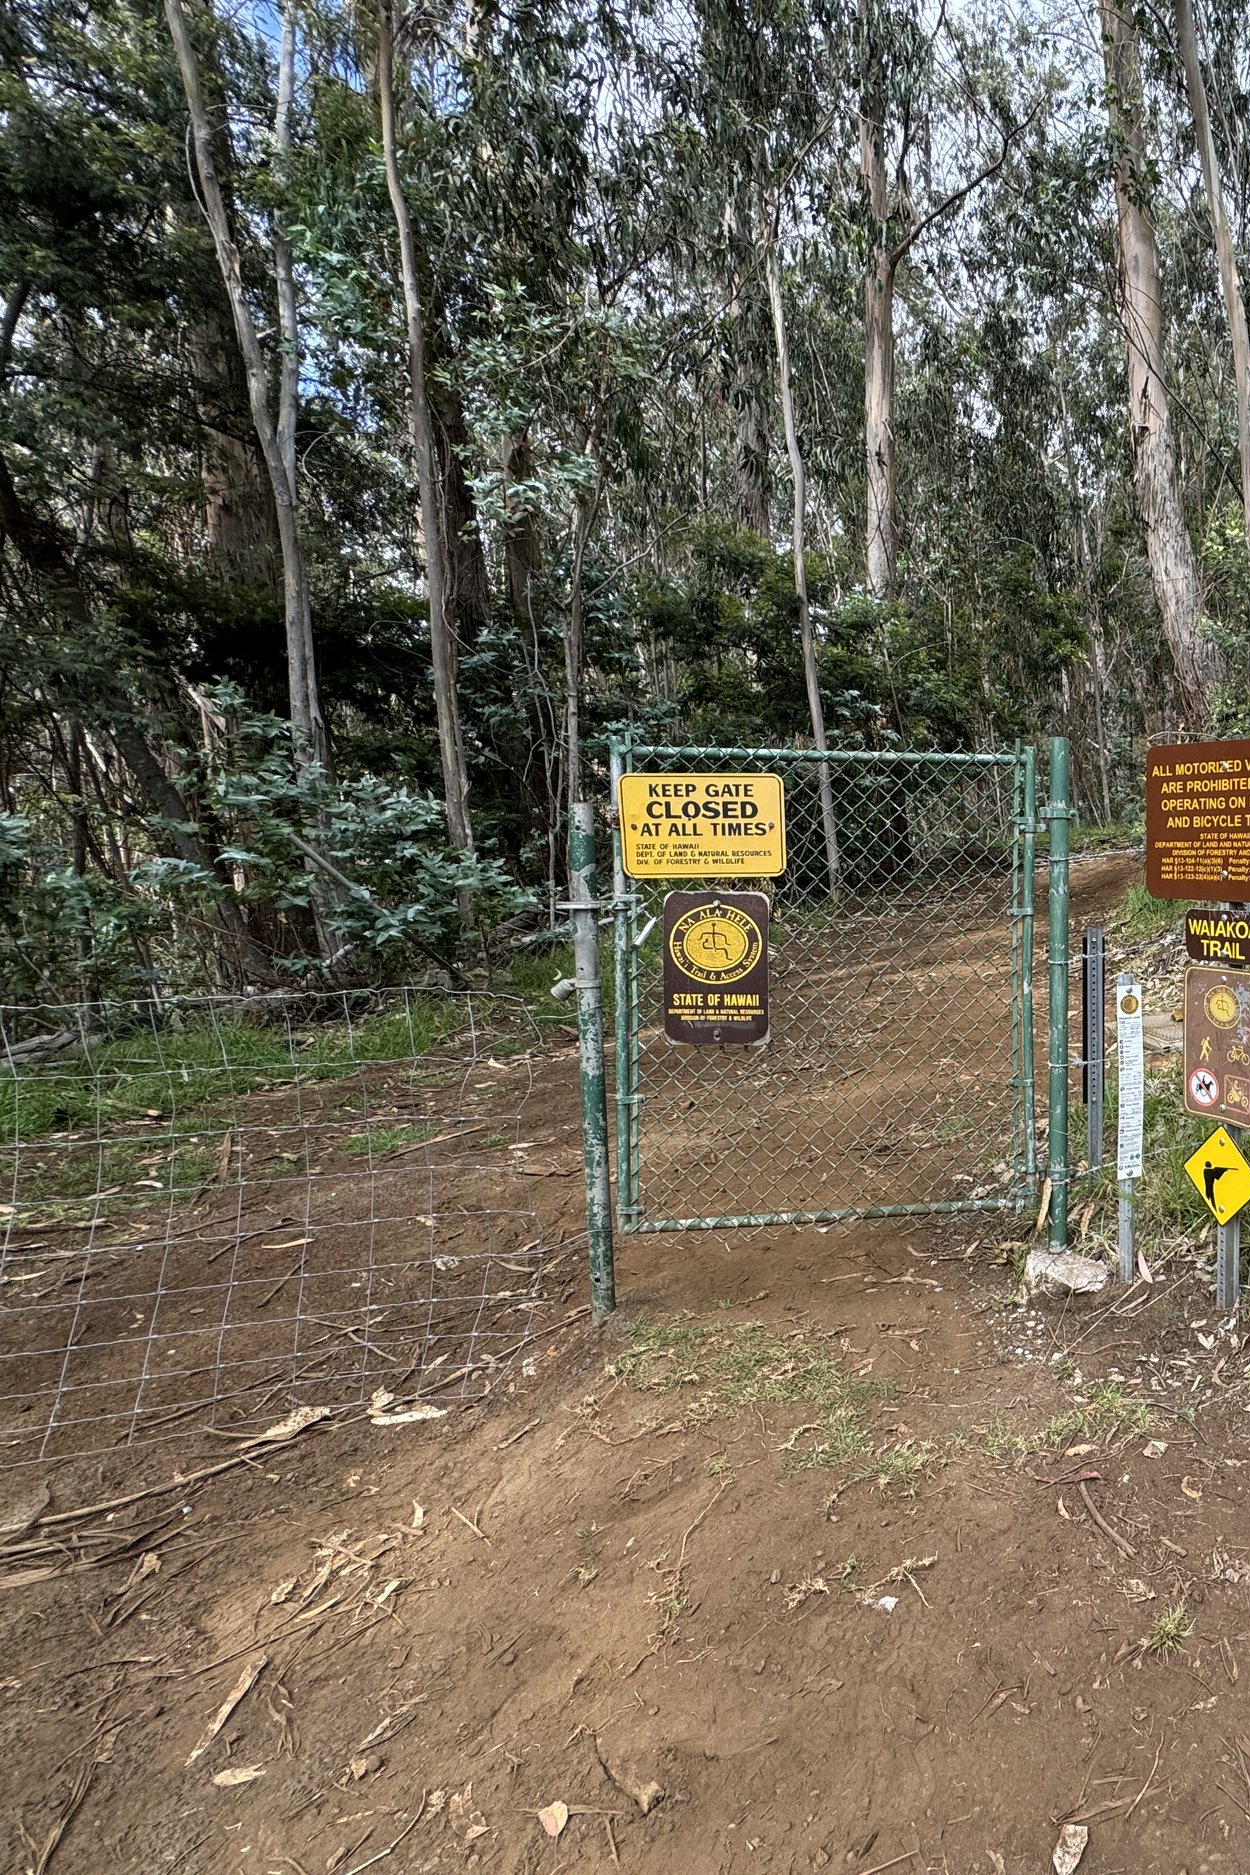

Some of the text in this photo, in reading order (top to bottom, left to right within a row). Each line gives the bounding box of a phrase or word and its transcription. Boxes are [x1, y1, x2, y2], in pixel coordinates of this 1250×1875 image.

[1152, 765, 1172, 777] ALL
[1176, 759, 1242, 775] MOTORIZED
[648, 783, 754, 798] KEEP GATE
[1161, 781, 1183, 794] ARE
[646, 800, 758, 819] CLOSED
[1161, 797, 1225, 811] OPERATING
[1229, 797, 1246, 809] ON
[1167, 816, 1190, 828] AND
[1193, 814, 1242, 828] BICYCLE
[640, 822, 767, 837] AT ALL TIMES
[678, 908, 753, 933] NA ALA HELE
[1200, 940, 1245, 960] TRAIL
[690, 965, 706, 978] Trail
[710, 972, 716, 980] &
[720, 968, 743, 980] Access
[743, 942, 758, 967] System
[673, 994, 759, 1006] STATE OF HAWAII
